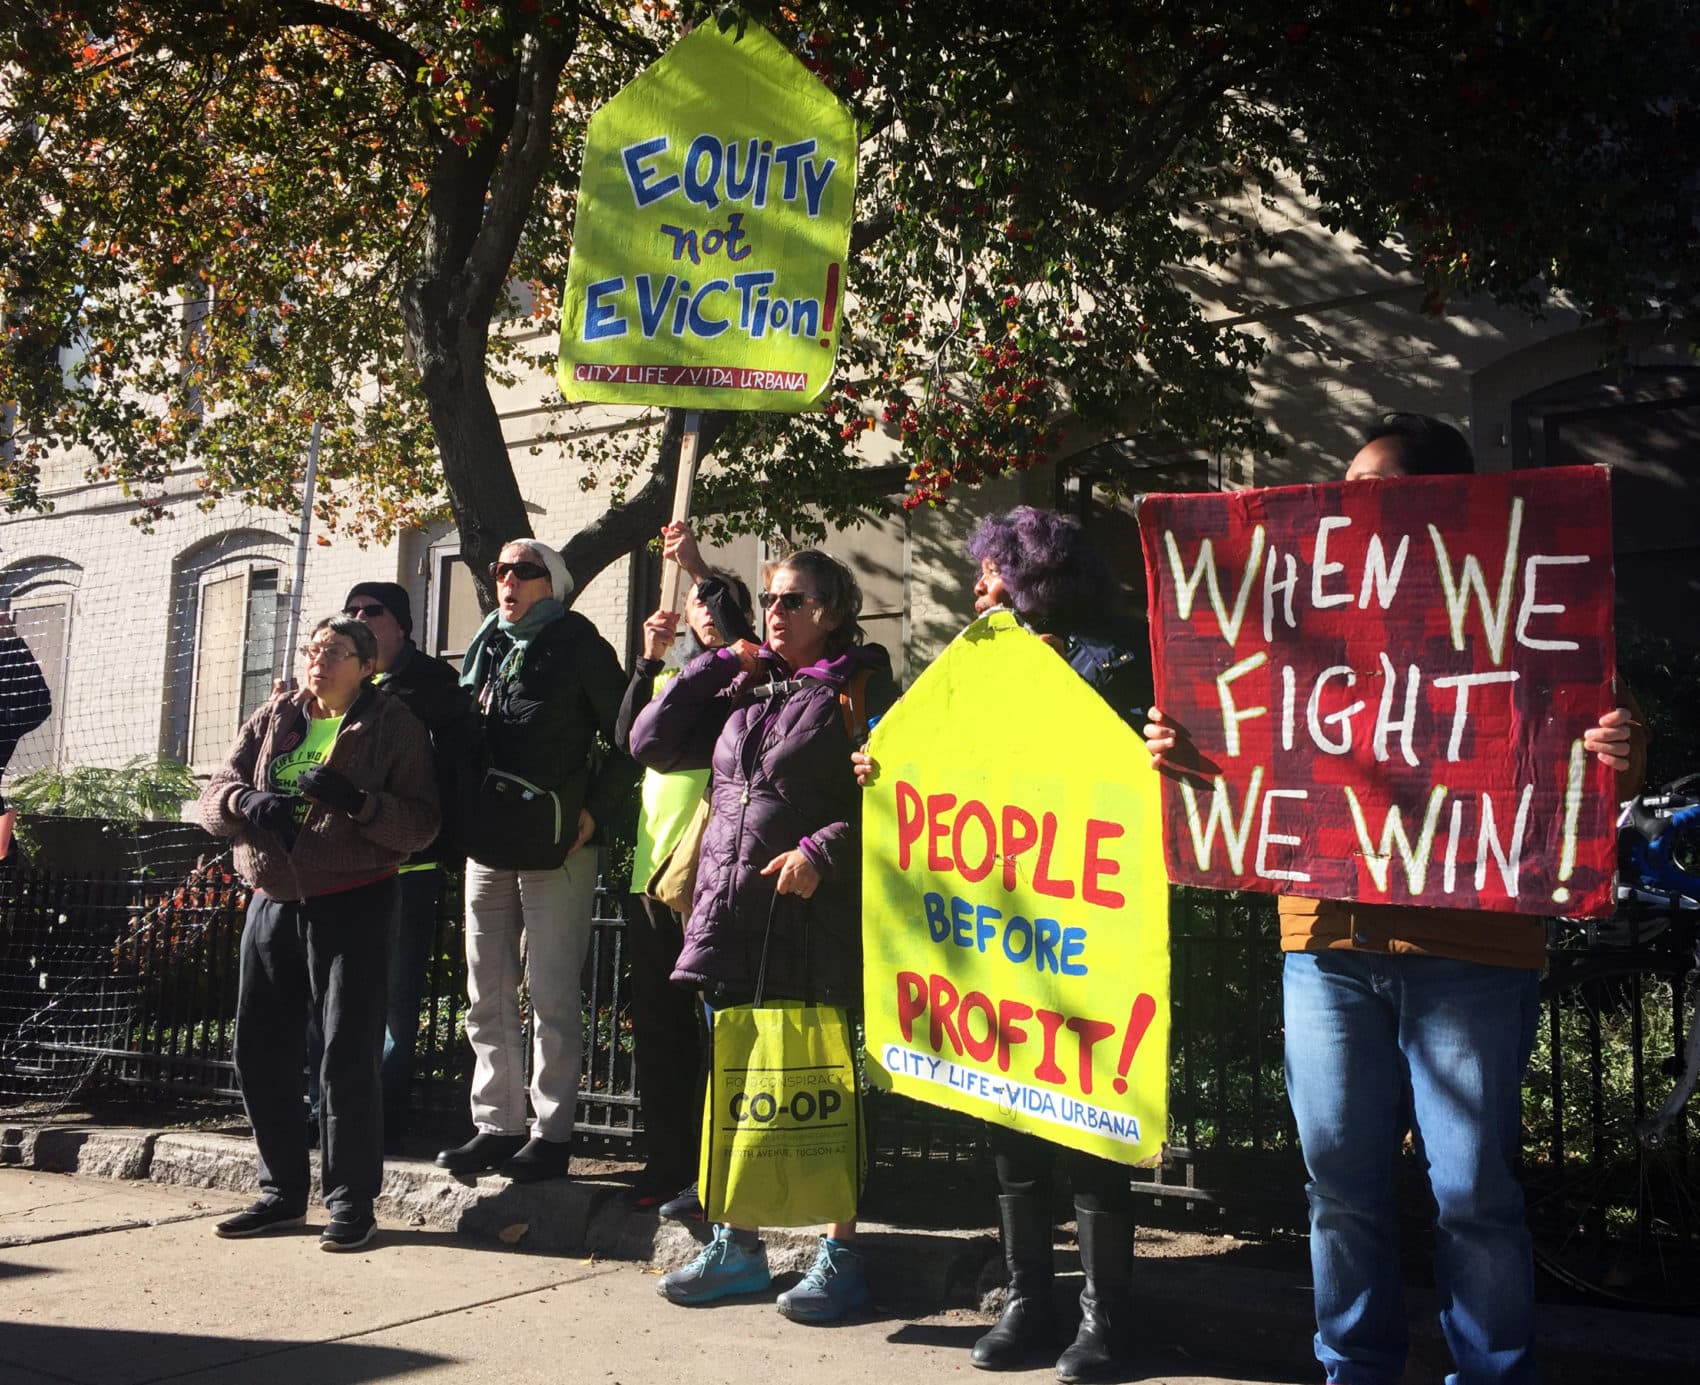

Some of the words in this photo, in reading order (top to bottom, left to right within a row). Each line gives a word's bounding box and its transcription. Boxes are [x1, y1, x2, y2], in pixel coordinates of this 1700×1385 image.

[661, 213, 752, 265] not
[576, 366, 620, 382] CITY
[626, 367, 668, 384] LIFE
[740, 371, 806, 390] URBANA
[1164, 516, 1410, 648] WHEN
[1427, 496, 1591, 665] WE
[1216, 651, 1522, 767] FIGHT
[896, 780, 1126, 909] PEOPLE
[1180, 766, 1311, 882] WE
[923, 892, 1088, 977] BEFORE
[896, 971, 1157, 1095] PROFIT!
[729, 1089, 841, 1123] CO-OP
[886, 1047, 941, 1080] CITY
[1061, 1098, 1140, 1141] URBANA
